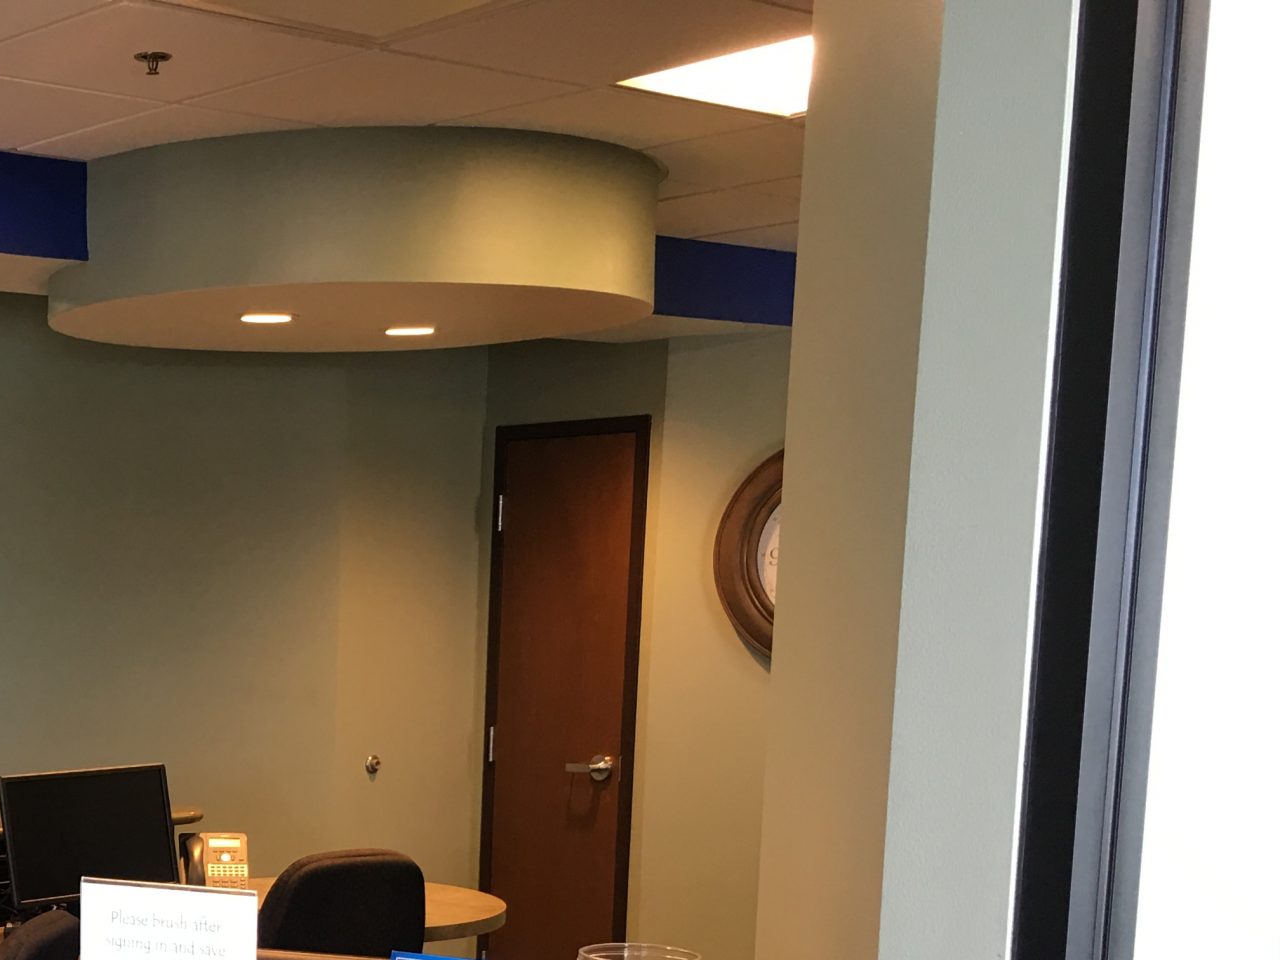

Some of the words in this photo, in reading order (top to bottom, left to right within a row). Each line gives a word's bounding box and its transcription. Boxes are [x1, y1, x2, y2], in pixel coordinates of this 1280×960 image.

[111, 909, 149, 927] Please
[152, 912, 188, 929] brush
[192, 915, 222, 933] after
[105, 936, 151, 954] signing
[155, 941, 167, 953] in
[172, 941, 195, 956] and
[199, 945, 227, 957] save
